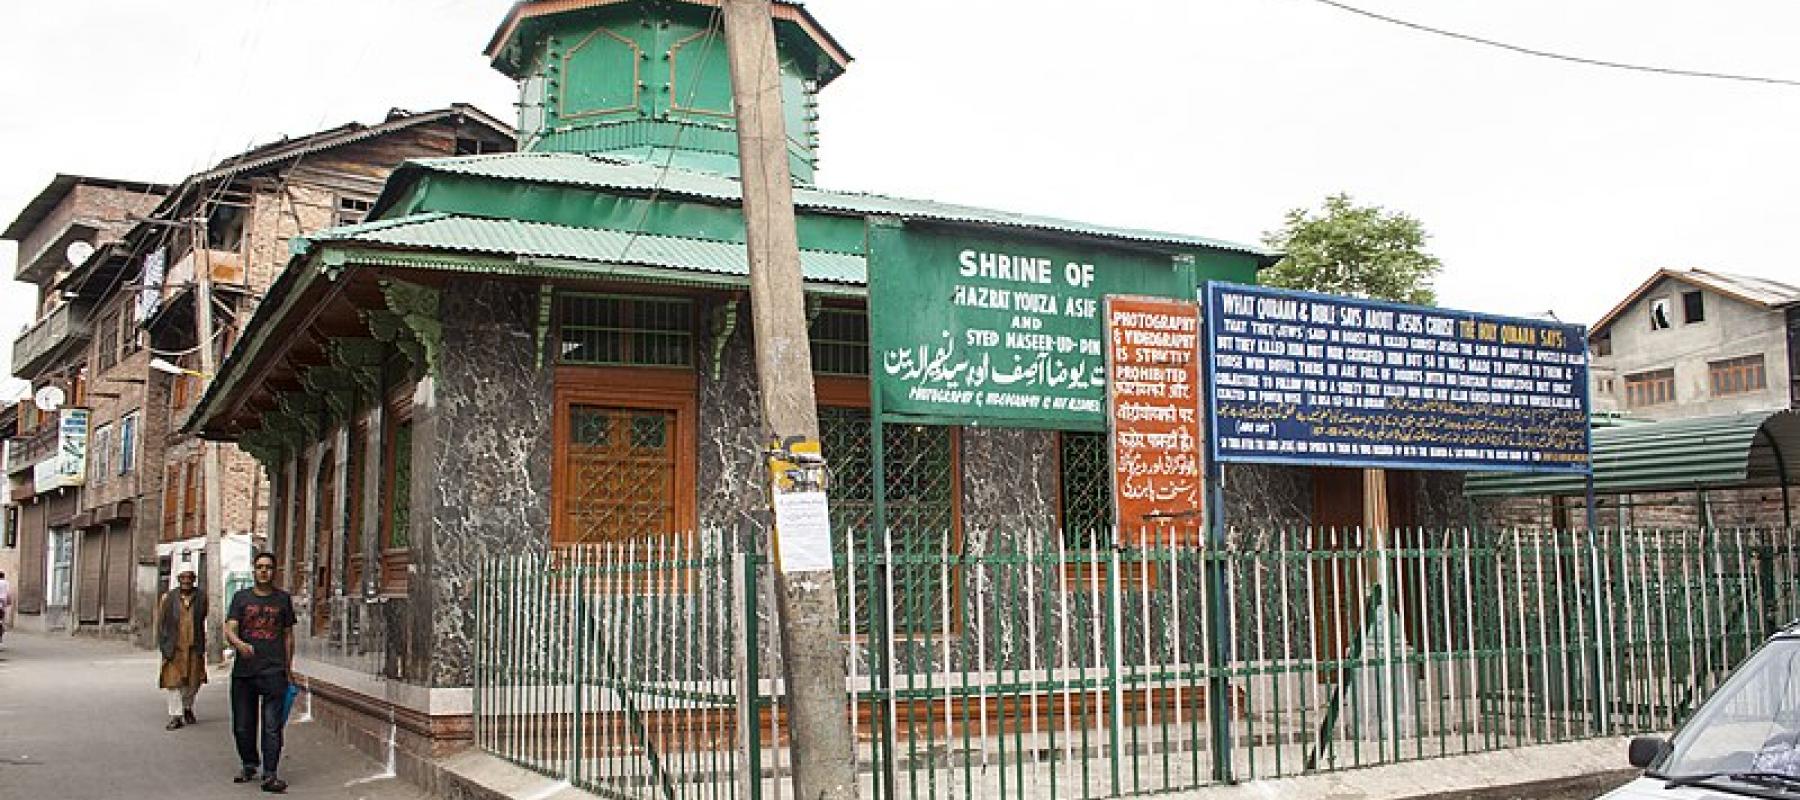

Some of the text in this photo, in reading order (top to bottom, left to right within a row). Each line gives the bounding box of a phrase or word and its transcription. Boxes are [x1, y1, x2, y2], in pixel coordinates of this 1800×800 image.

[960, 249, 1095, 288] SHRINE OF
[954, 285, 1096, 318] HAZRAT YOUZA ASIF
[1011, 316, 1043, 331] AND
[1113, 312, 1196, 331] PHOTOGRAPHY
[1222, 293, 1254, 316] WHAT
[1257, 297, 1296, 320] QURAAN
[1298, 302, 1308, 321] &
[1340, 306, 1361, 327] SAYS
[1364, 309, 1393, 330] ABOUT
[1396, 312, 1422, 333] JESUS
[1459, 319, 1474, 338] THE
[1477, 322, 1497, 341] HOLY
[1500, 325, 1535, 344] QURAAN
[966, 329, 999, 346] SYED
[1124, 329, 1196, 348] VIDEOGRAPHY
[1223, 318, 1246, 332] THAT
[1307, 327, 1327, 340] SAID
[1383, 335, 1408, 348] KILLED
[1116, 346, 1190, 363] IS STRICTLY
[1234, 337, 1255, 351] THEY
[1257, 339, 1286, 354] KILLED
[1116, 365, 1187, 382] PROHIBITED
